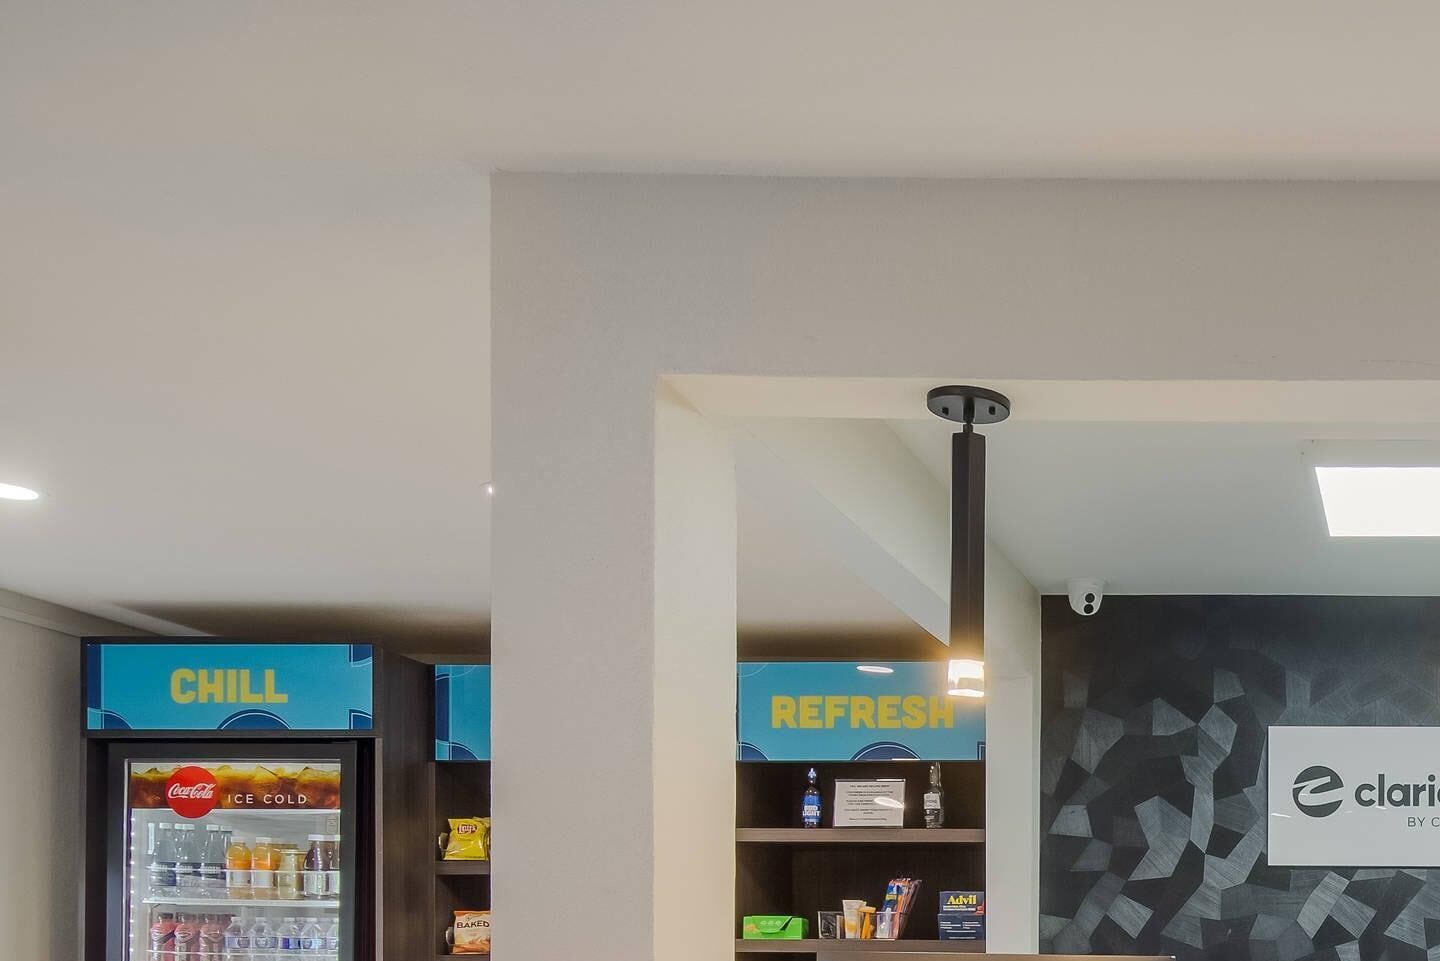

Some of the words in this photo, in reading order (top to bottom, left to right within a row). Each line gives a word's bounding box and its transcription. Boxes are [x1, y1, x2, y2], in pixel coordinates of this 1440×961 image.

[170, 668, 288, 704] CHILL
[771, 695, 955, 729] REFRESH
[168, 782, 217, 799] Coca-Cola
[227, 794, 255, 804] ICE
[263, 794, 307, 805] COLD
[1407, 817, 1426, 828] BY
[946, 894, 977, 905] Advil
[456, 919, 490, 929] BAKED
